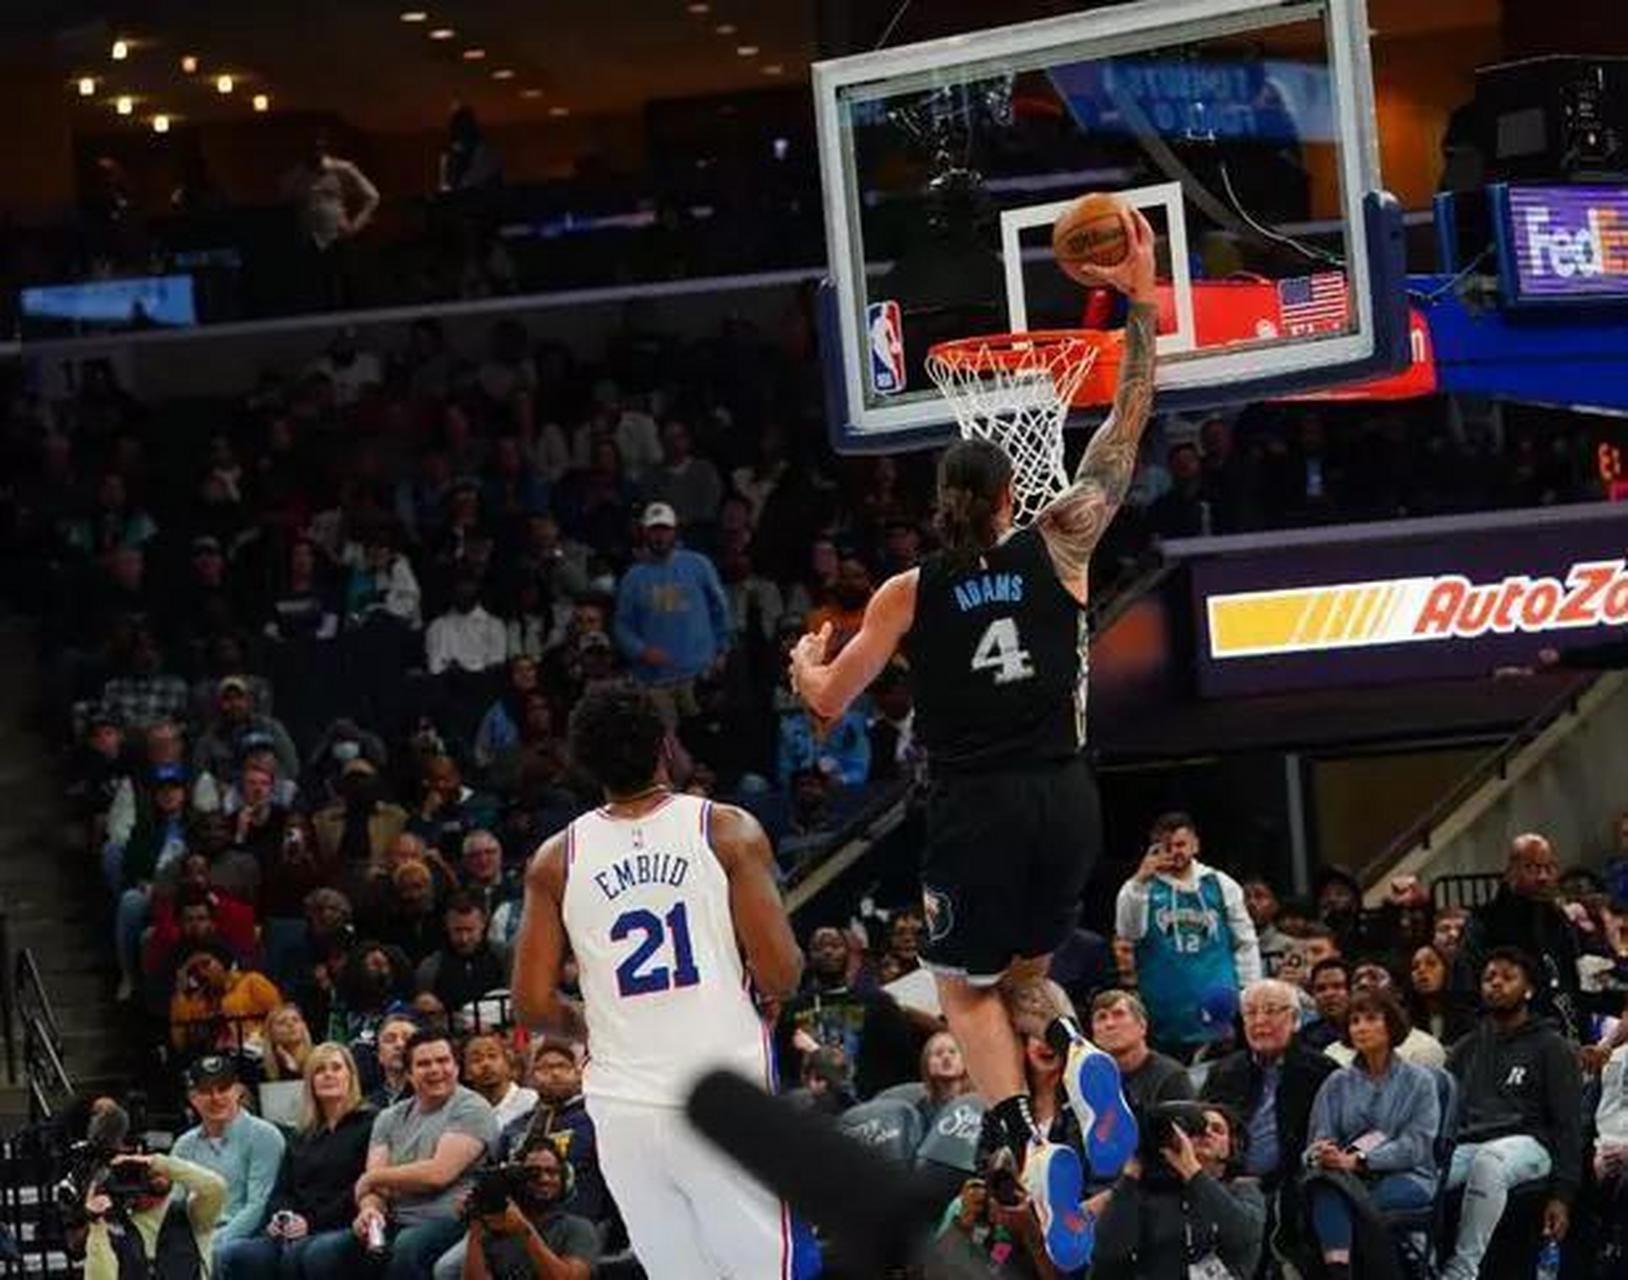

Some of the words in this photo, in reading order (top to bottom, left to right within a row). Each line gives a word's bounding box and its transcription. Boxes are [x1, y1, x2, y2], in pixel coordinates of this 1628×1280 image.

[954, 574, 1023, 612] ADAMS
[970, 617, 1034, 685] 4
[594, 853, 689, 900] EMBIID
[611, 901, 701, 998] 21
